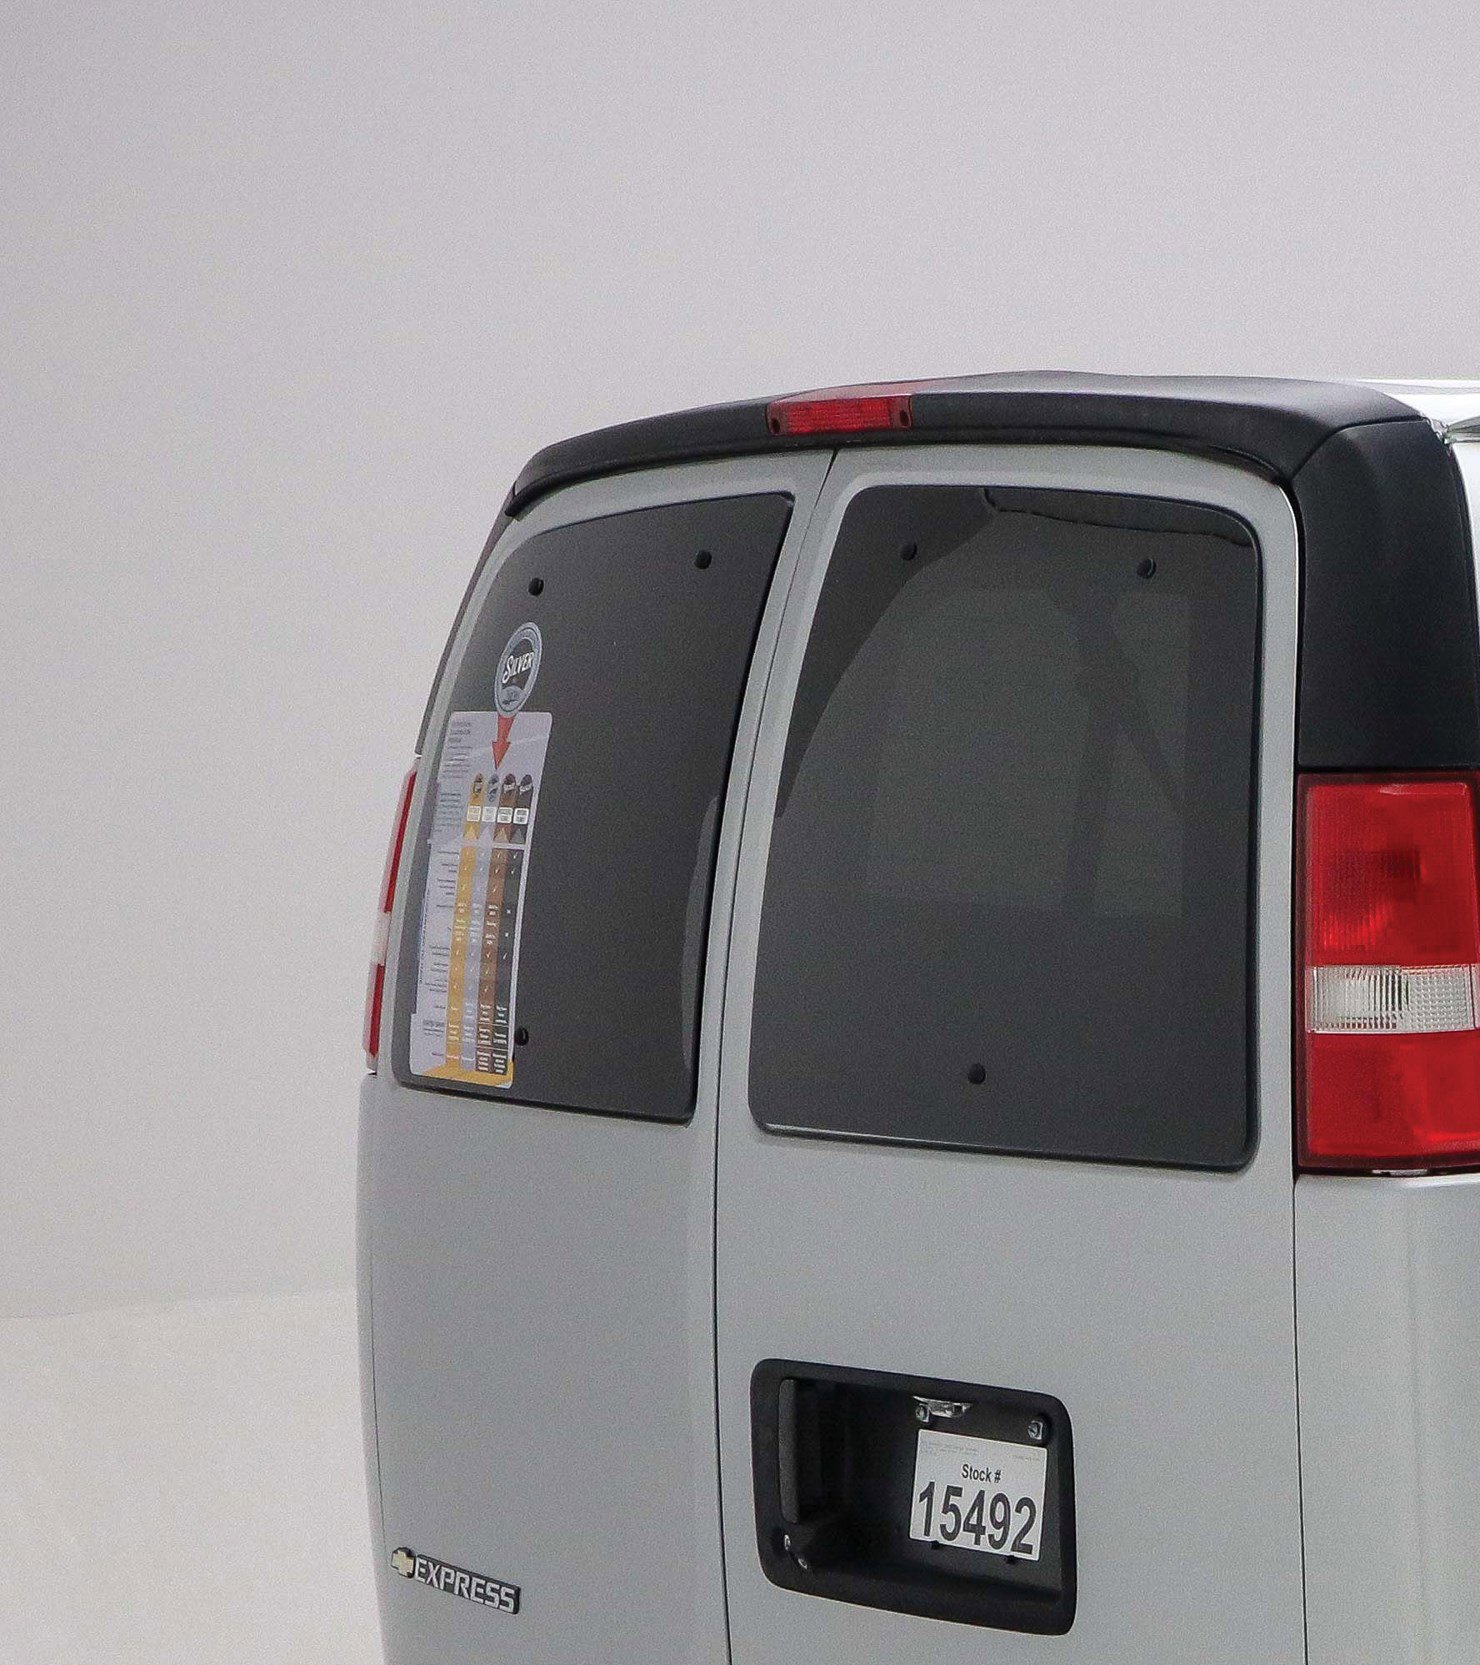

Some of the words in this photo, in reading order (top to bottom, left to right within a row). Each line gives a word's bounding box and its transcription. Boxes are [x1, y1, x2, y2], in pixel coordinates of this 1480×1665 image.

[501, 650, 534, 683] SILVER
[961, 1463, 992, 1483] Stock
[994, 1468, 1002, 1483] #
[918, 1481, 1037, 1554] 15492
[414, 1557, 515, 1613] EXPRESS
